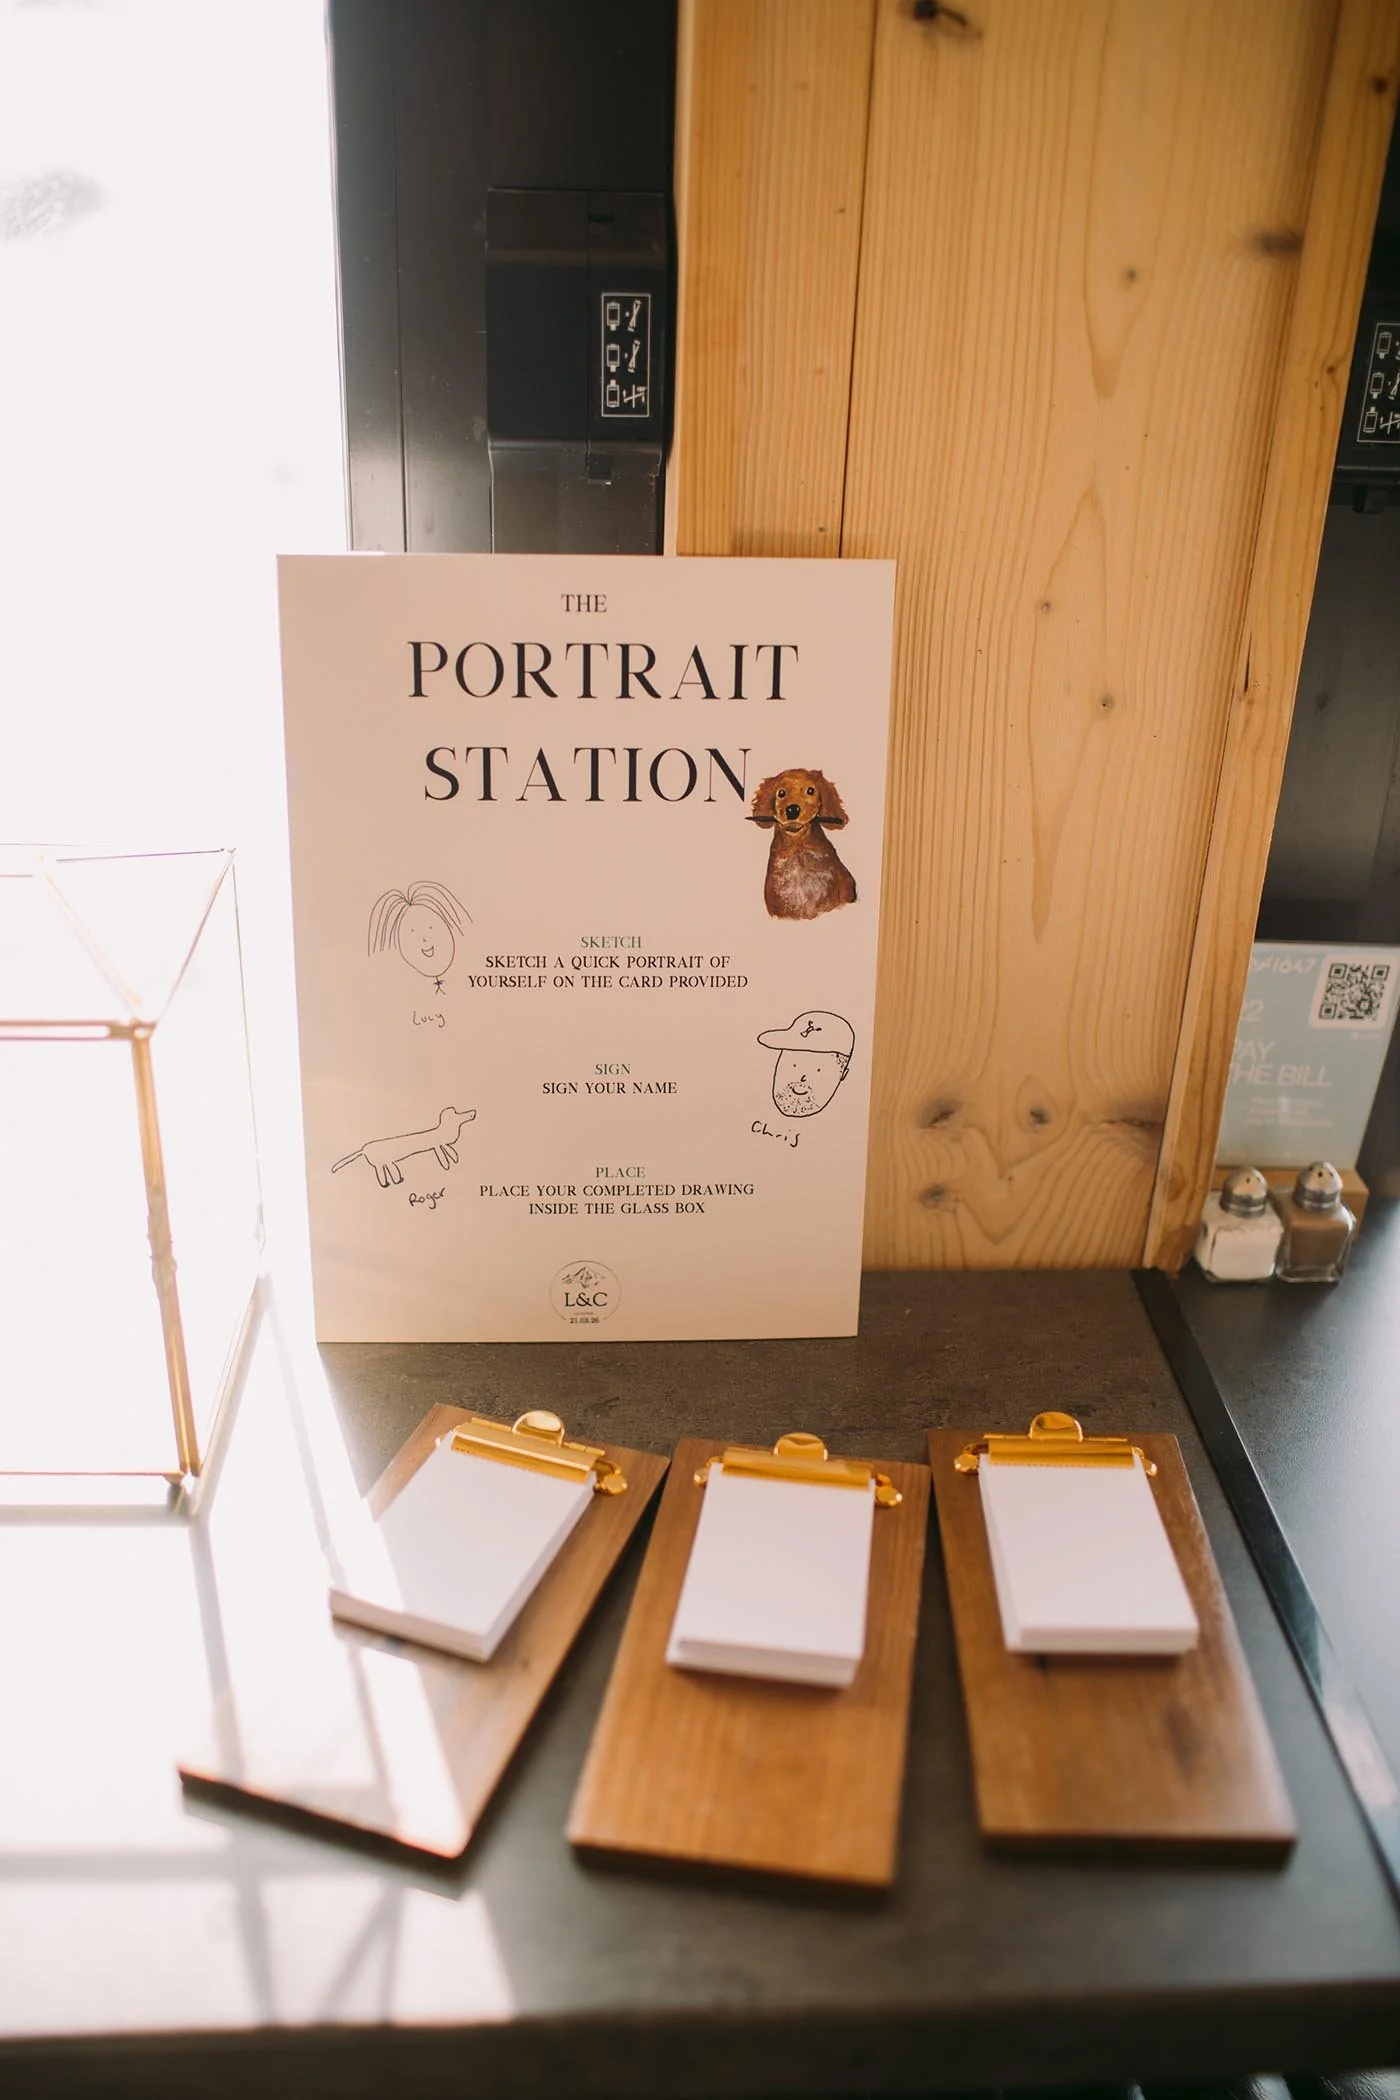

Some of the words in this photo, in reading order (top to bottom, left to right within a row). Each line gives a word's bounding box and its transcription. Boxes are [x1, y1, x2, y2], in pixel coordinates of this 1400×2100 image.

[561, 594, 608, 613] THE
[408, 642, 798, 700] PORTRAIT
[425, 747, 752, 802] STATION
[581, 936, 641, 948] SKETCH
[486, 956, 546, 968] SKETCH
[554, 957, 564, 968] A
[572, 956, 620, 970] QUICK
[627, 956, 703, 968] PORTRAIT
[710, 956, 730, 968] OF
[468, 976, 547, 987] YOURSELF
[553, 976, 574, 987] ON
[581, 976, 612, 988] THE
[619, 976, 663, 988] CARD
[670, 976, 748, 987] PROVIDED
[413, 1011, 445, 1028] Lucy
[595, 1064, 630, 1075] SIGN
[543, 1082, 577, 1094] SIGN
[585, 1082, 625, 1094] YOUR
[633, 1082, 676, 1094] NAME
[751, 1121, 800, 1148] Chris
[596, 1167, 645, 1178] PLACE
[480, 1186, 529, 1196] PLACE
[537, 1185, 576, 1196] YOUR
[583, 1185, 675, 1196] COMPLETED
[682, 1184, 754, 1195] DRAWING
[409, 1187, 445, 1209] Roger
[529, 1203, 578, 1214] INSIDE
[585, 1203, 614, 1214] THE
[621, 1203, 669, 1214] GLASS
[676, 1202, 704, 1213] BOX
[565, 1292, 607, 1307] L&C
